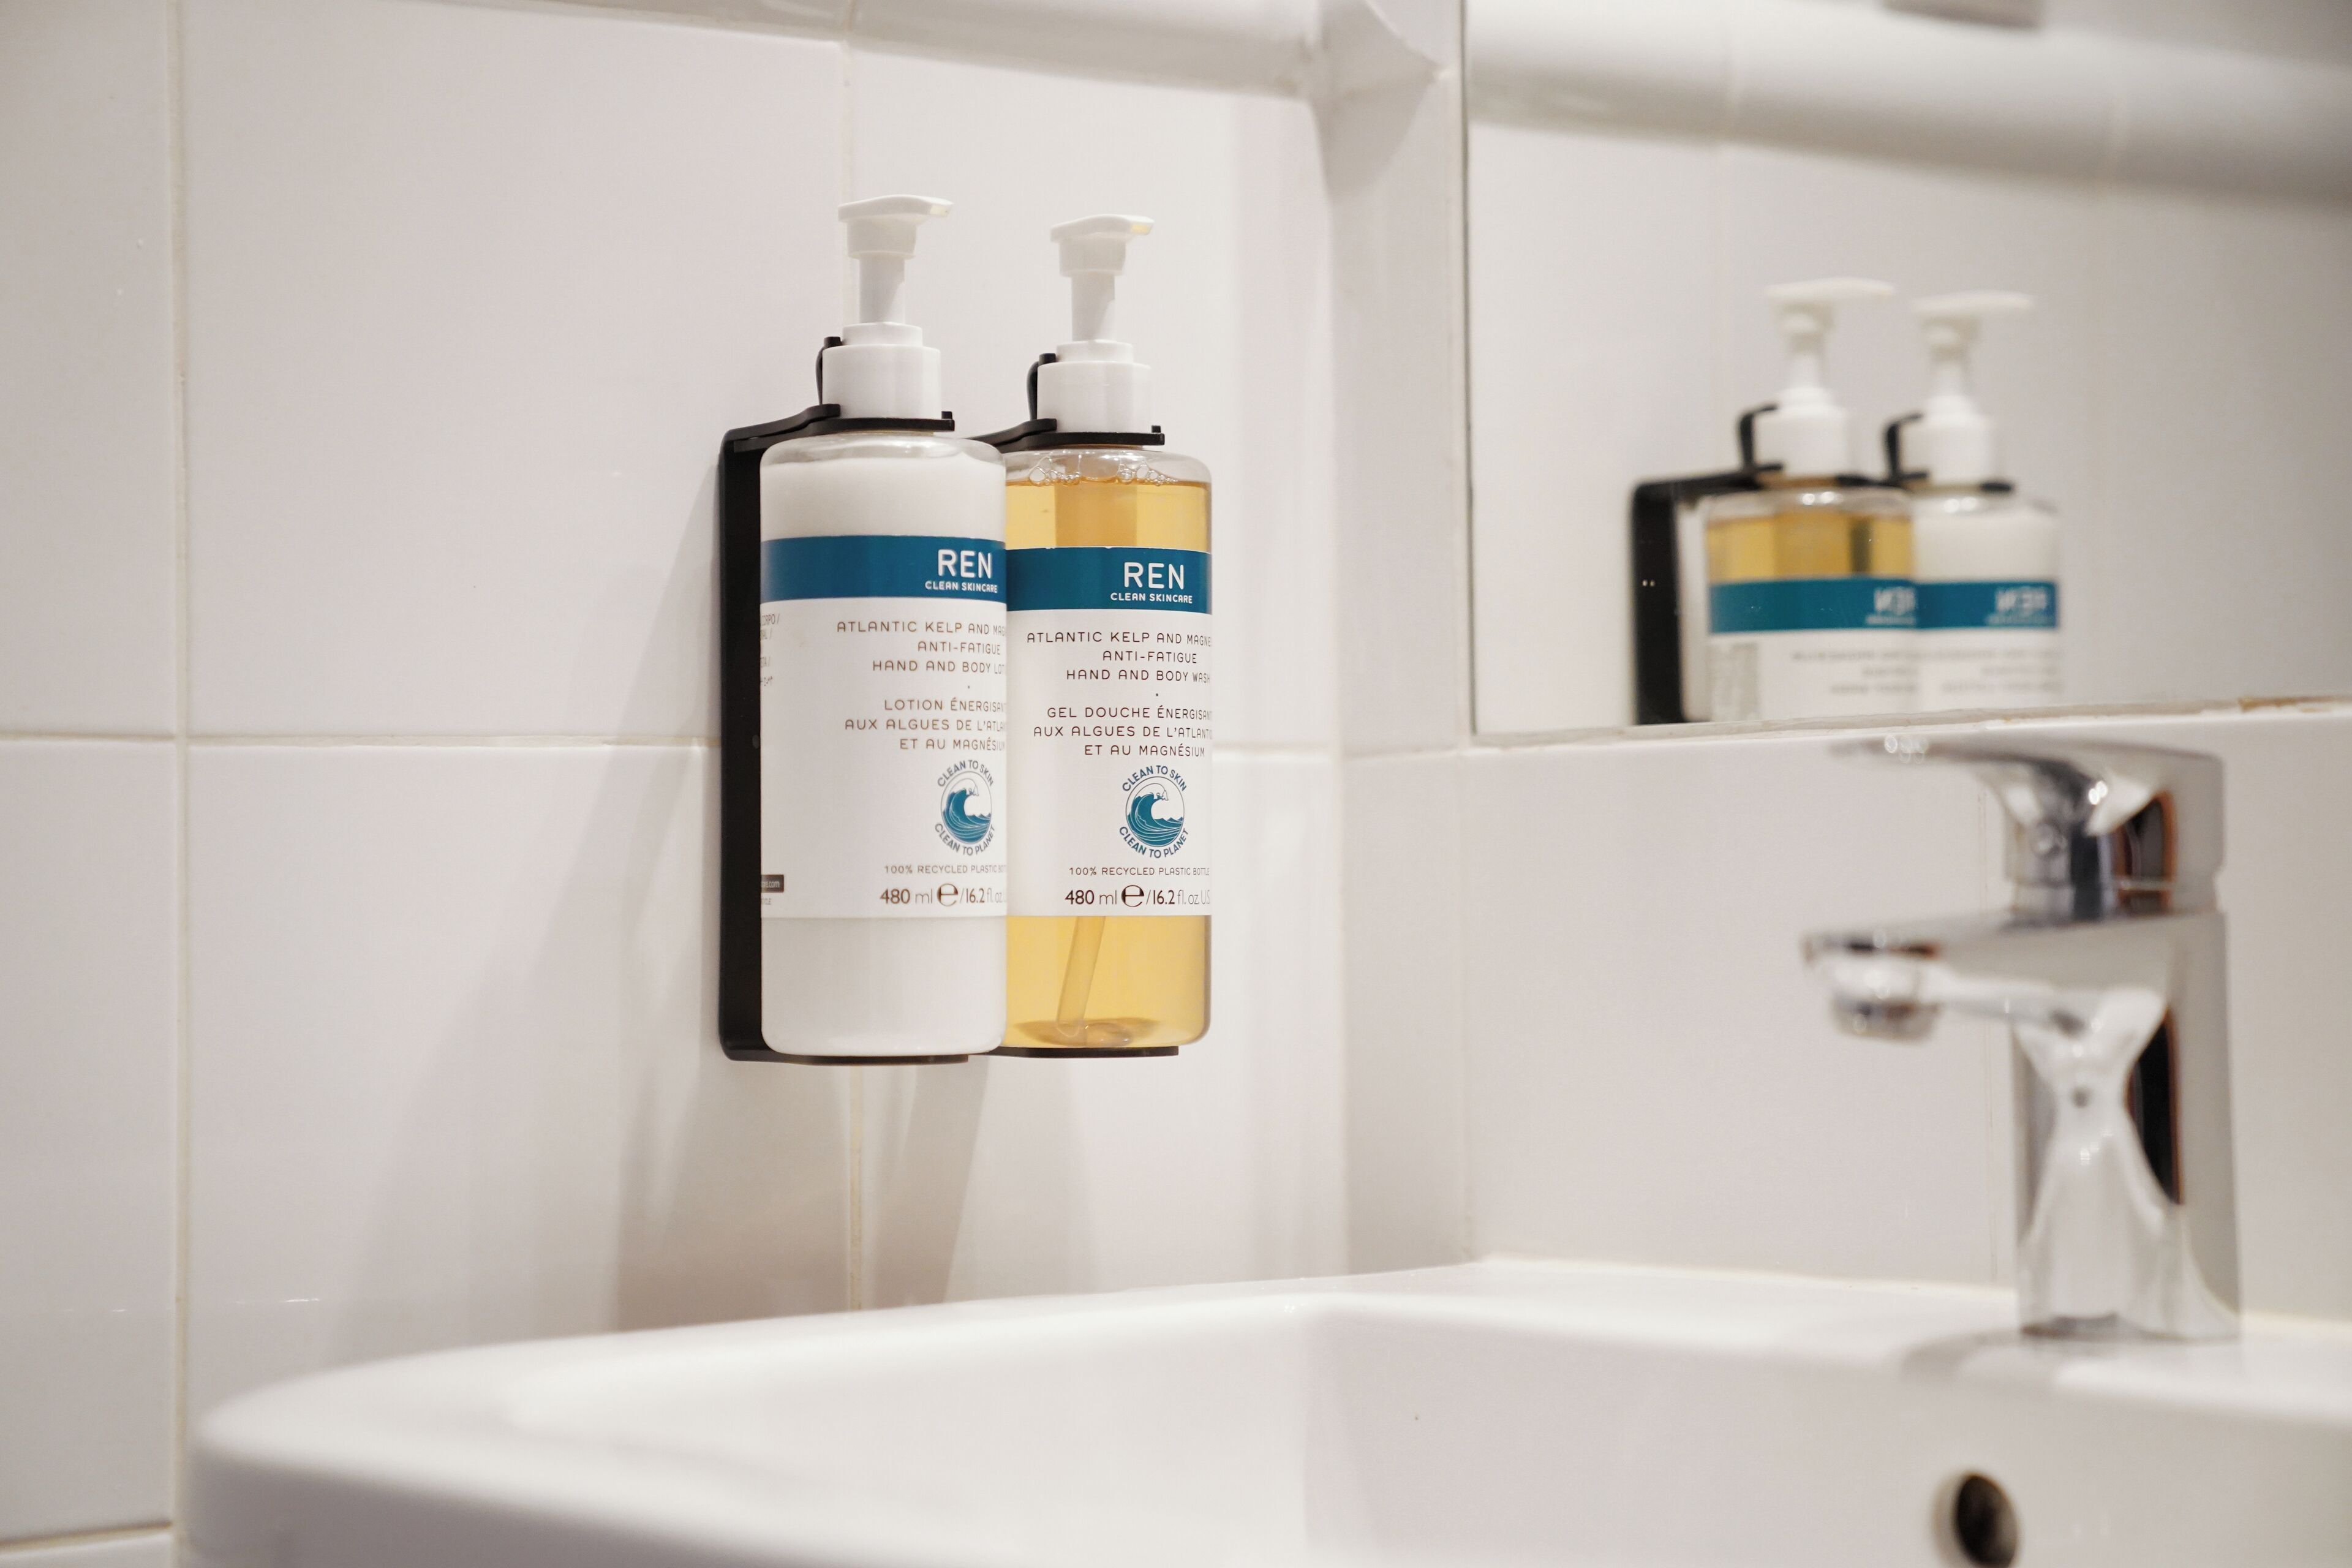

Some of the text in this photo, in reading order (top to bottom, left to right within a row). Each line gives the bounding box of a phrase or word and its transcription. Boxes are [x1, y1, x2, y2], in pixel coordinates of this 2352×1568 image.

[938, 549, 992, 579] REN
[1123, 562, 1185, 590] REN
[925, 580, 998, 594] CLEAN SKINCARE
[1110, 592, 1193, 604] CLEAN SKINCARE
[837, 620, 918, 633] ATLANTIC
[925, 621, 962, 633] KELP
[968, 622, 990, 635] AND
[1027, 631, 1103, 643] ATLANTIC
[1110, 631, 1150, 643] KELP
[1156, 633, 1182, 644] AND
[918, 641, 1001, 655] ANTI-FATIGUE
[1102, 650, 1197, 664] ANTI-FATIGUE
[872, 660, 918, 672] HAND
[925, 660, 956, 673] AND
[962, 661, 991, 673] BODY
[1066, 669, 1210, 684] HAND AND BODY WASH
[884, 699, 943, 711] LOTION
[1047, 707, 1077, 718] GEL
[1085, 707, 1151, 718] DOUCHE
[845, 718, 878, 731] AUX
[886, 718, 950, 731] ALGUES
[956, 719, 972, 731] DE
[1033, 726, 1064, 737] AUX
[1071, 726, 1136, 737] ALGUES
[1142, 726, 1161, 737] DE
[899, 738, 918, 750] ET
[925, 738, 946, 750] AU
[1084, 743, 1205, 758] ET AU MAGNÉSIUM
[937, 759, 994, 788] CLEAN TO SKIN
[1122, 764, 1188, 792] CLEAN TO SKIN
[934, 823, 996, 856] CLEAN TO PLANET
[1119, 826, 1189, 859] CLEAN TO PLANET
[884, 864, 913, 875] 100%
[917, 864, 968, 874] RECYCLED
[971, 864, 997, 873] PLASTIC
[1068, 866, 1097, 876] 100%
[1101, 867, 1155, 876] RECYCLED
[1158, 867, 1191, 876] PLASTIC
[880, 888, 911, 904] 480
[914, 888, 933, 904] ml
[1065, 889, 1095, 905] 480
[1099, 889, 1118, 905] ml
